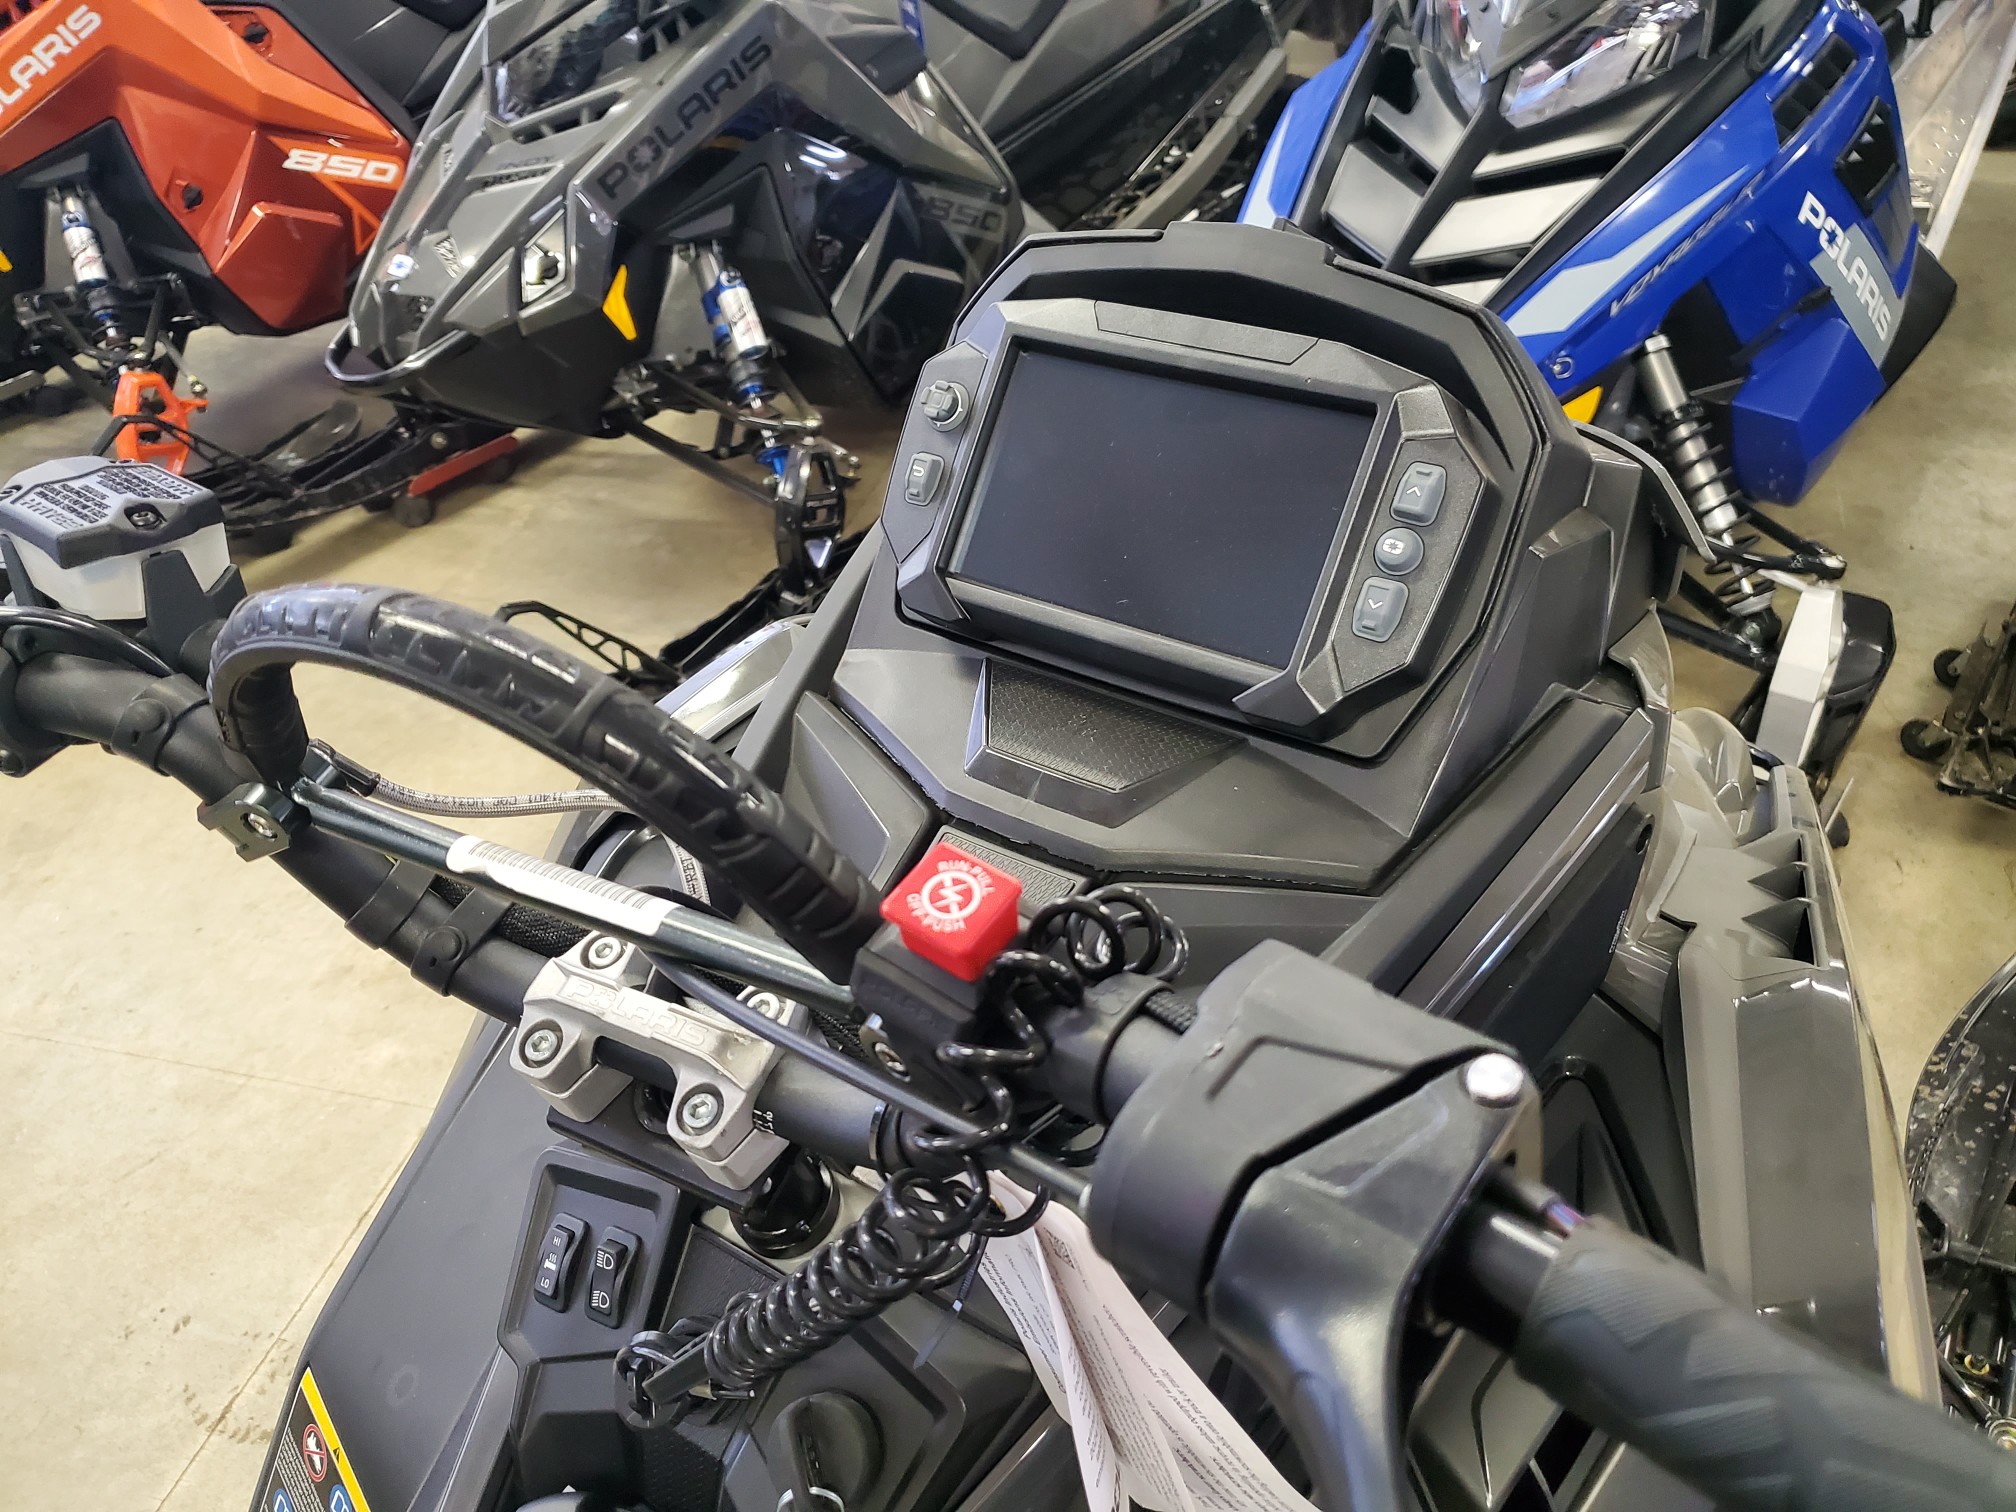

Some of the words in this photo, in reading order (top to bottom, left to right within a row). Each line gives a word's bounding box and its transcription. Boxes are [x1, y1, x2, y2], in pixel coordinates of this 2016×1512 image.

[0, 4, 101, 114] LARIS
[597, 35, 773, 199] POLARIS
[282, 148, 399, 184] 850
[924, 197, 1002, 232] 850
[1798, 190, 1892, 342] POLARIS
[566, 981, 710, 1047] POLARIS
[553, 1236, 561, 1247] HI
[540, 1276, 550, 1289] LO
